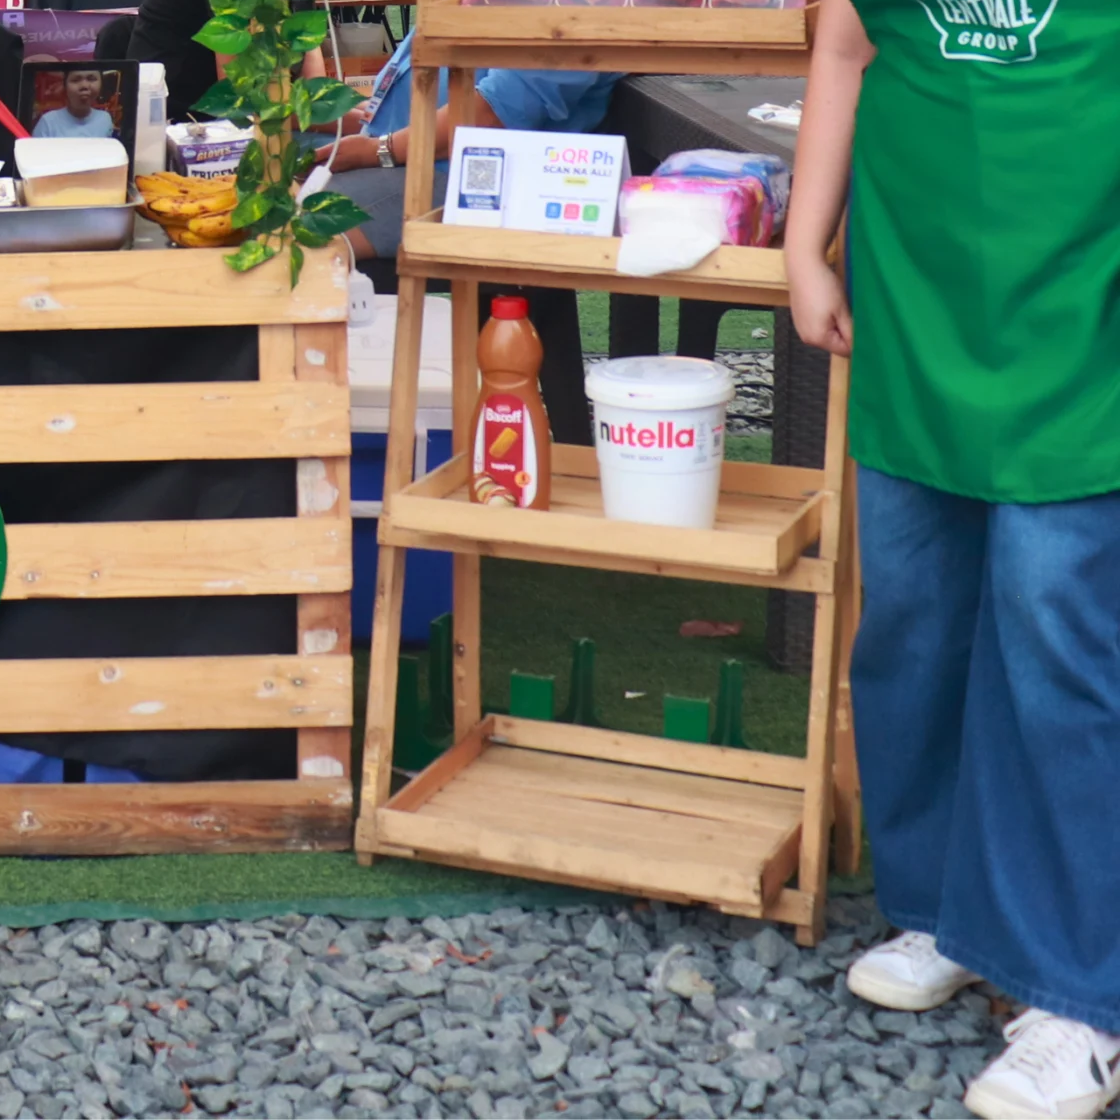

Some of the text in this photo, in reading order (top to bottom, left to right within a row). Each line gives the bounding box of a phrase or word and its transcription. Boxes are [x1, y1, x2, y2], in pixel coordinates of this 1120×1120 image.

[957, 31, 1018, 51] GROUP
[196, 146, 232, 161] GLOVES
[562, 148, 614, 165] QR Ph
[543, 165, 570, 174] SCAN
[572, 166, 588, 175] NA
[600, 420, 695, 449] nutella
